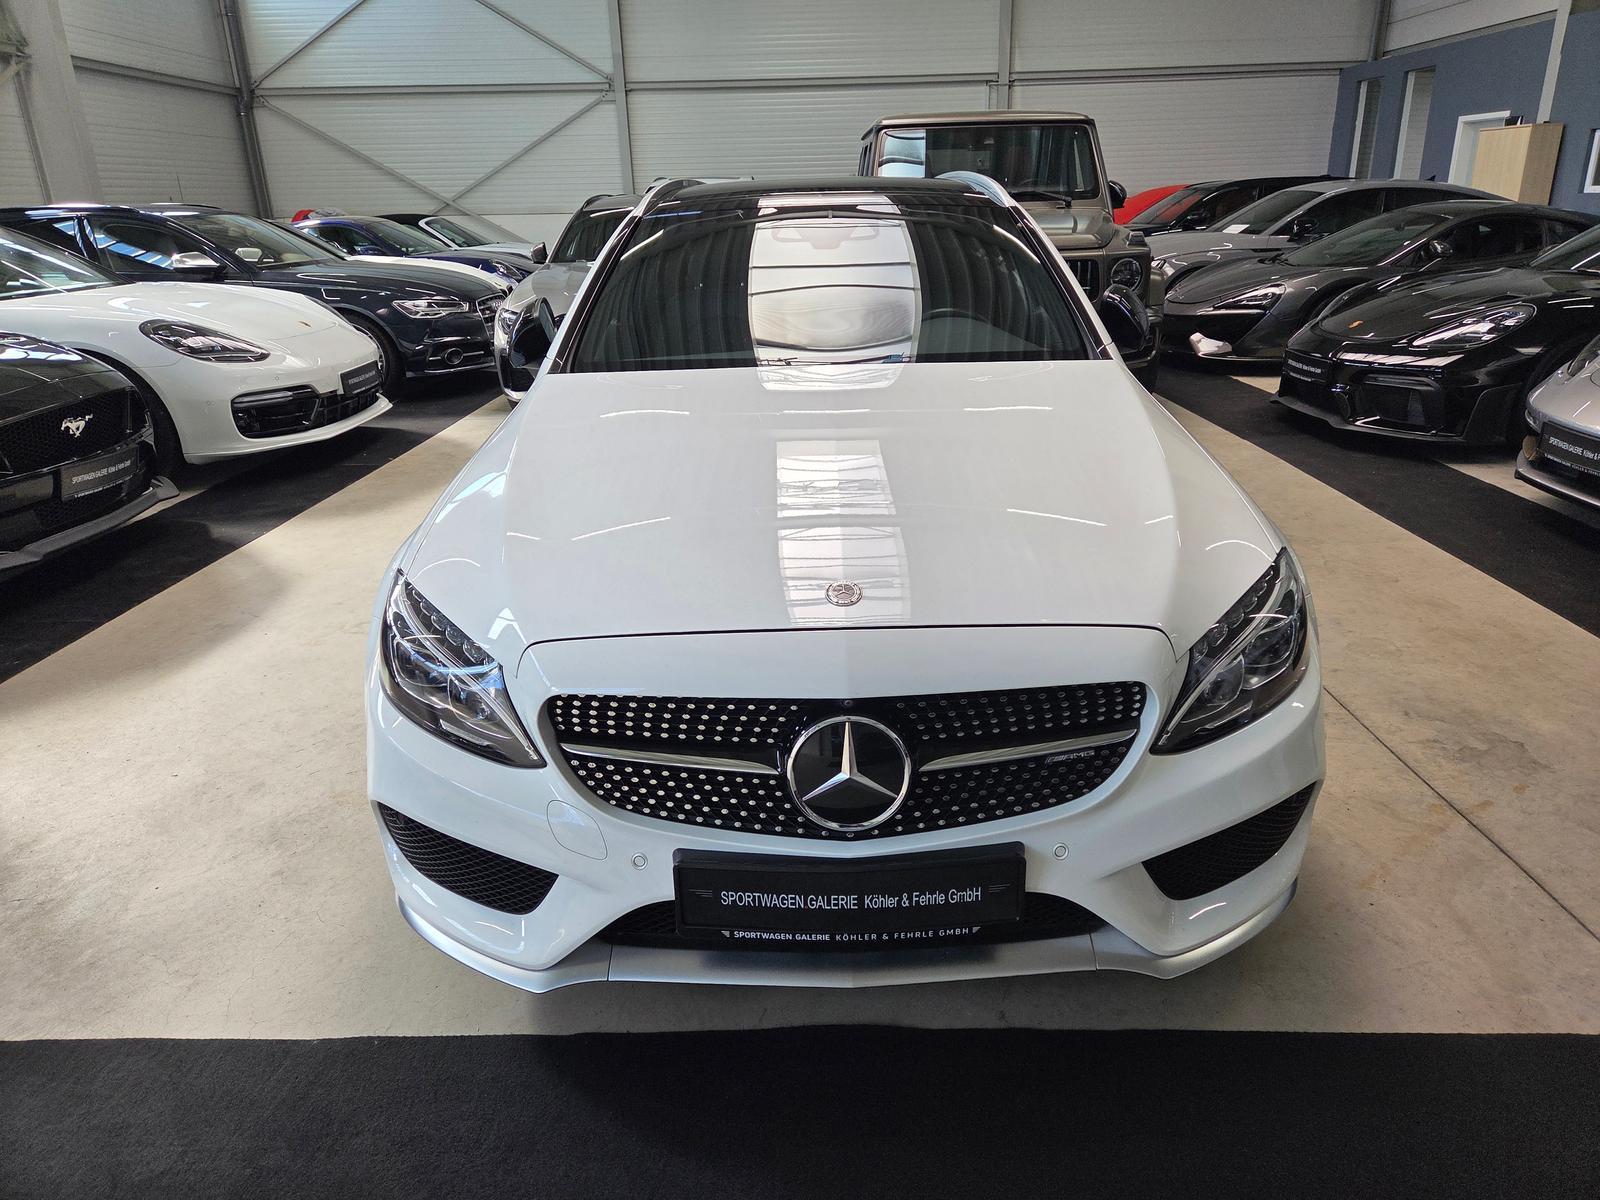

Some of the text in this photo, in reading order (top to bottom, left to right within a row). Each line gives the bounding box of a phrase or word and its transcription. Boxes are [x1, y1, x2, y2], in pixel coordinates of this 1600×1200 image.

[864, 893, 899, 909] Köhler
[901, 892, 910, 907] &
[912, 890, 946, 906] Fehrle
[948, 886, 982, 903] GmbH
[835, 932, 877, 942] KÖHLER
[894, 930, 934, 940] FEHRLE
[939, 927, 969, 937] GMBH
